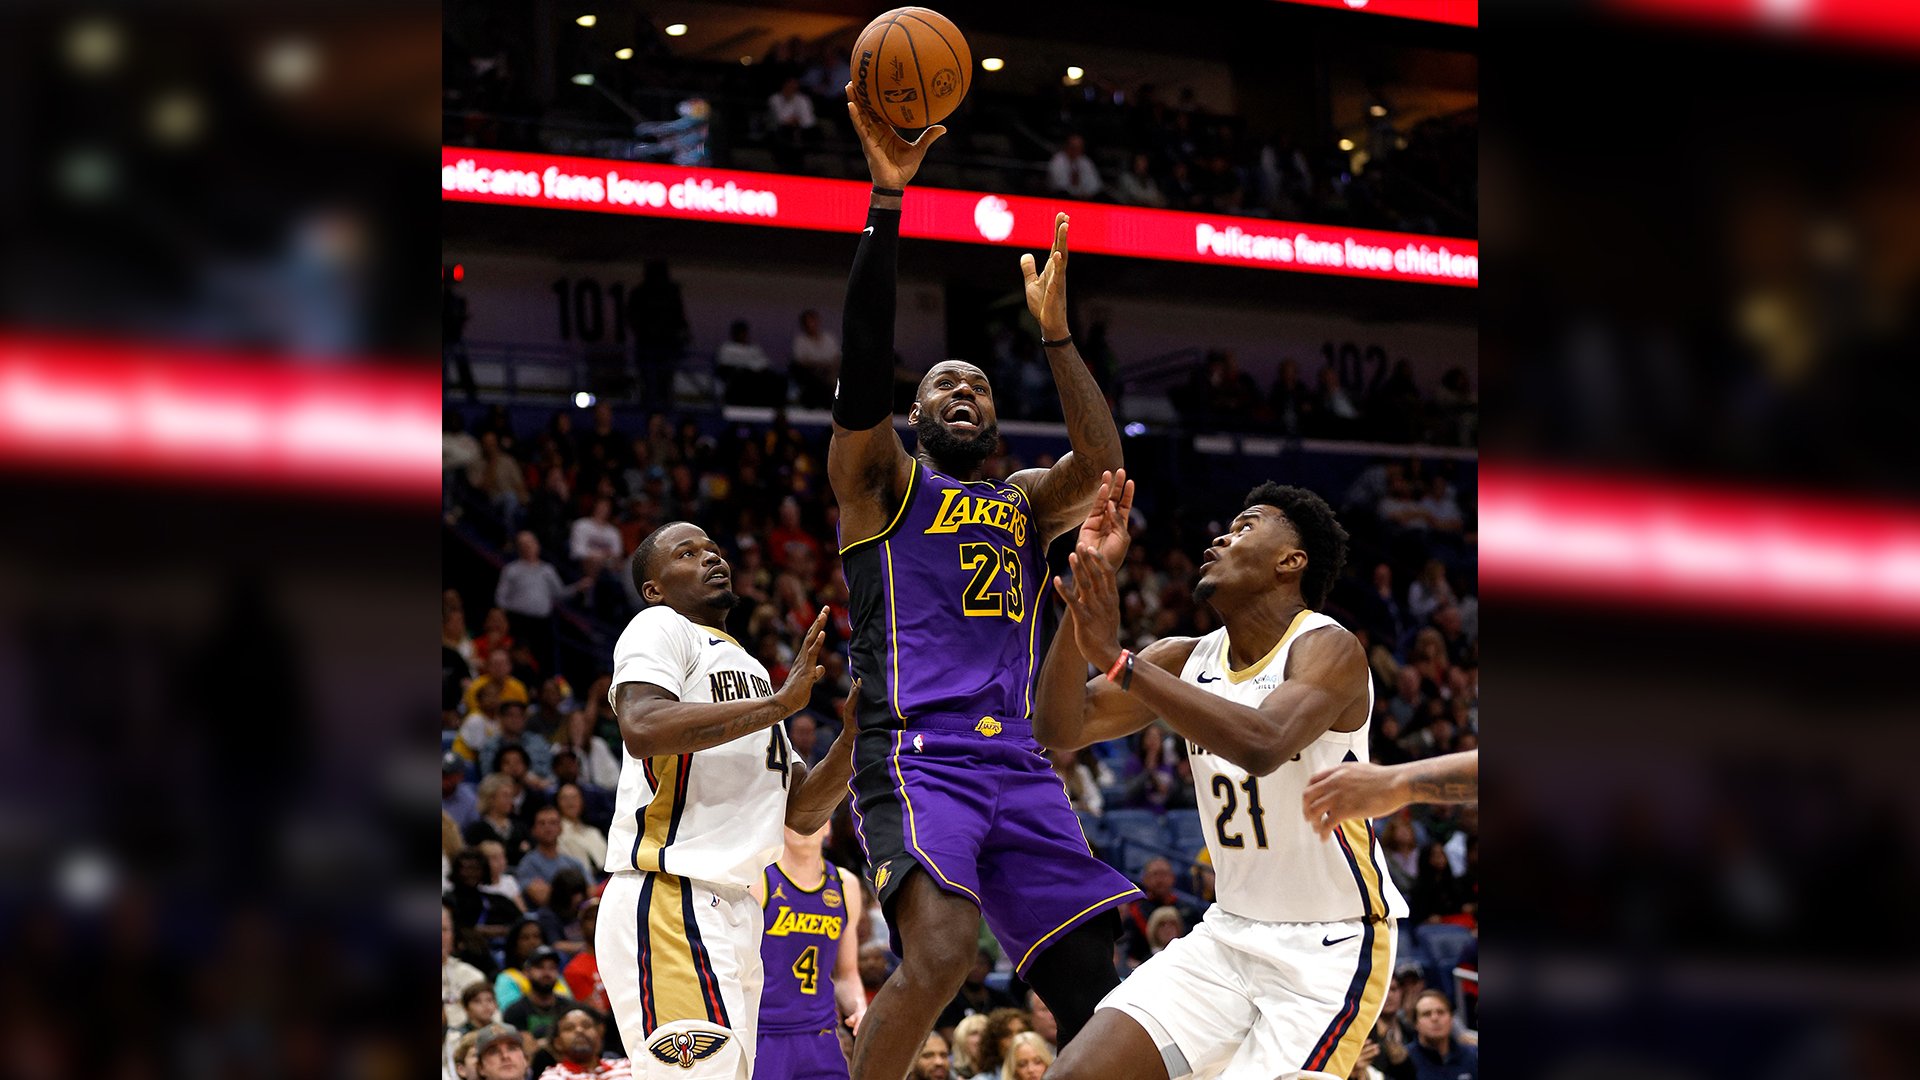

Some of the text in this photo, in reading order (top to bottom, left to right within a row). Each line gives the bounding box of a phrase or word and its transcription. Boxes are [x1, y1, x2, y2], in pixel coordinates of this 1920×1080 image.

[542, 165, 605, 203] fans
[606, 171, 668, 208] love
[668, 177, 778, 218] chicken
[1196, 223, 1478, 280] Pelicans fans love chicken
[555, 279, 624, 341] 101
[924, 488, 1028, 548] LAKERS
[959, 541, 1025, 624] 23
[709, 670, 751, 703] NEW
[766, 723, 790, 791] 4
[1211, 772, 1270, 850] 21
[765, 905, 843, 940] LAKERS
[791, 944, 819, 995] 4
